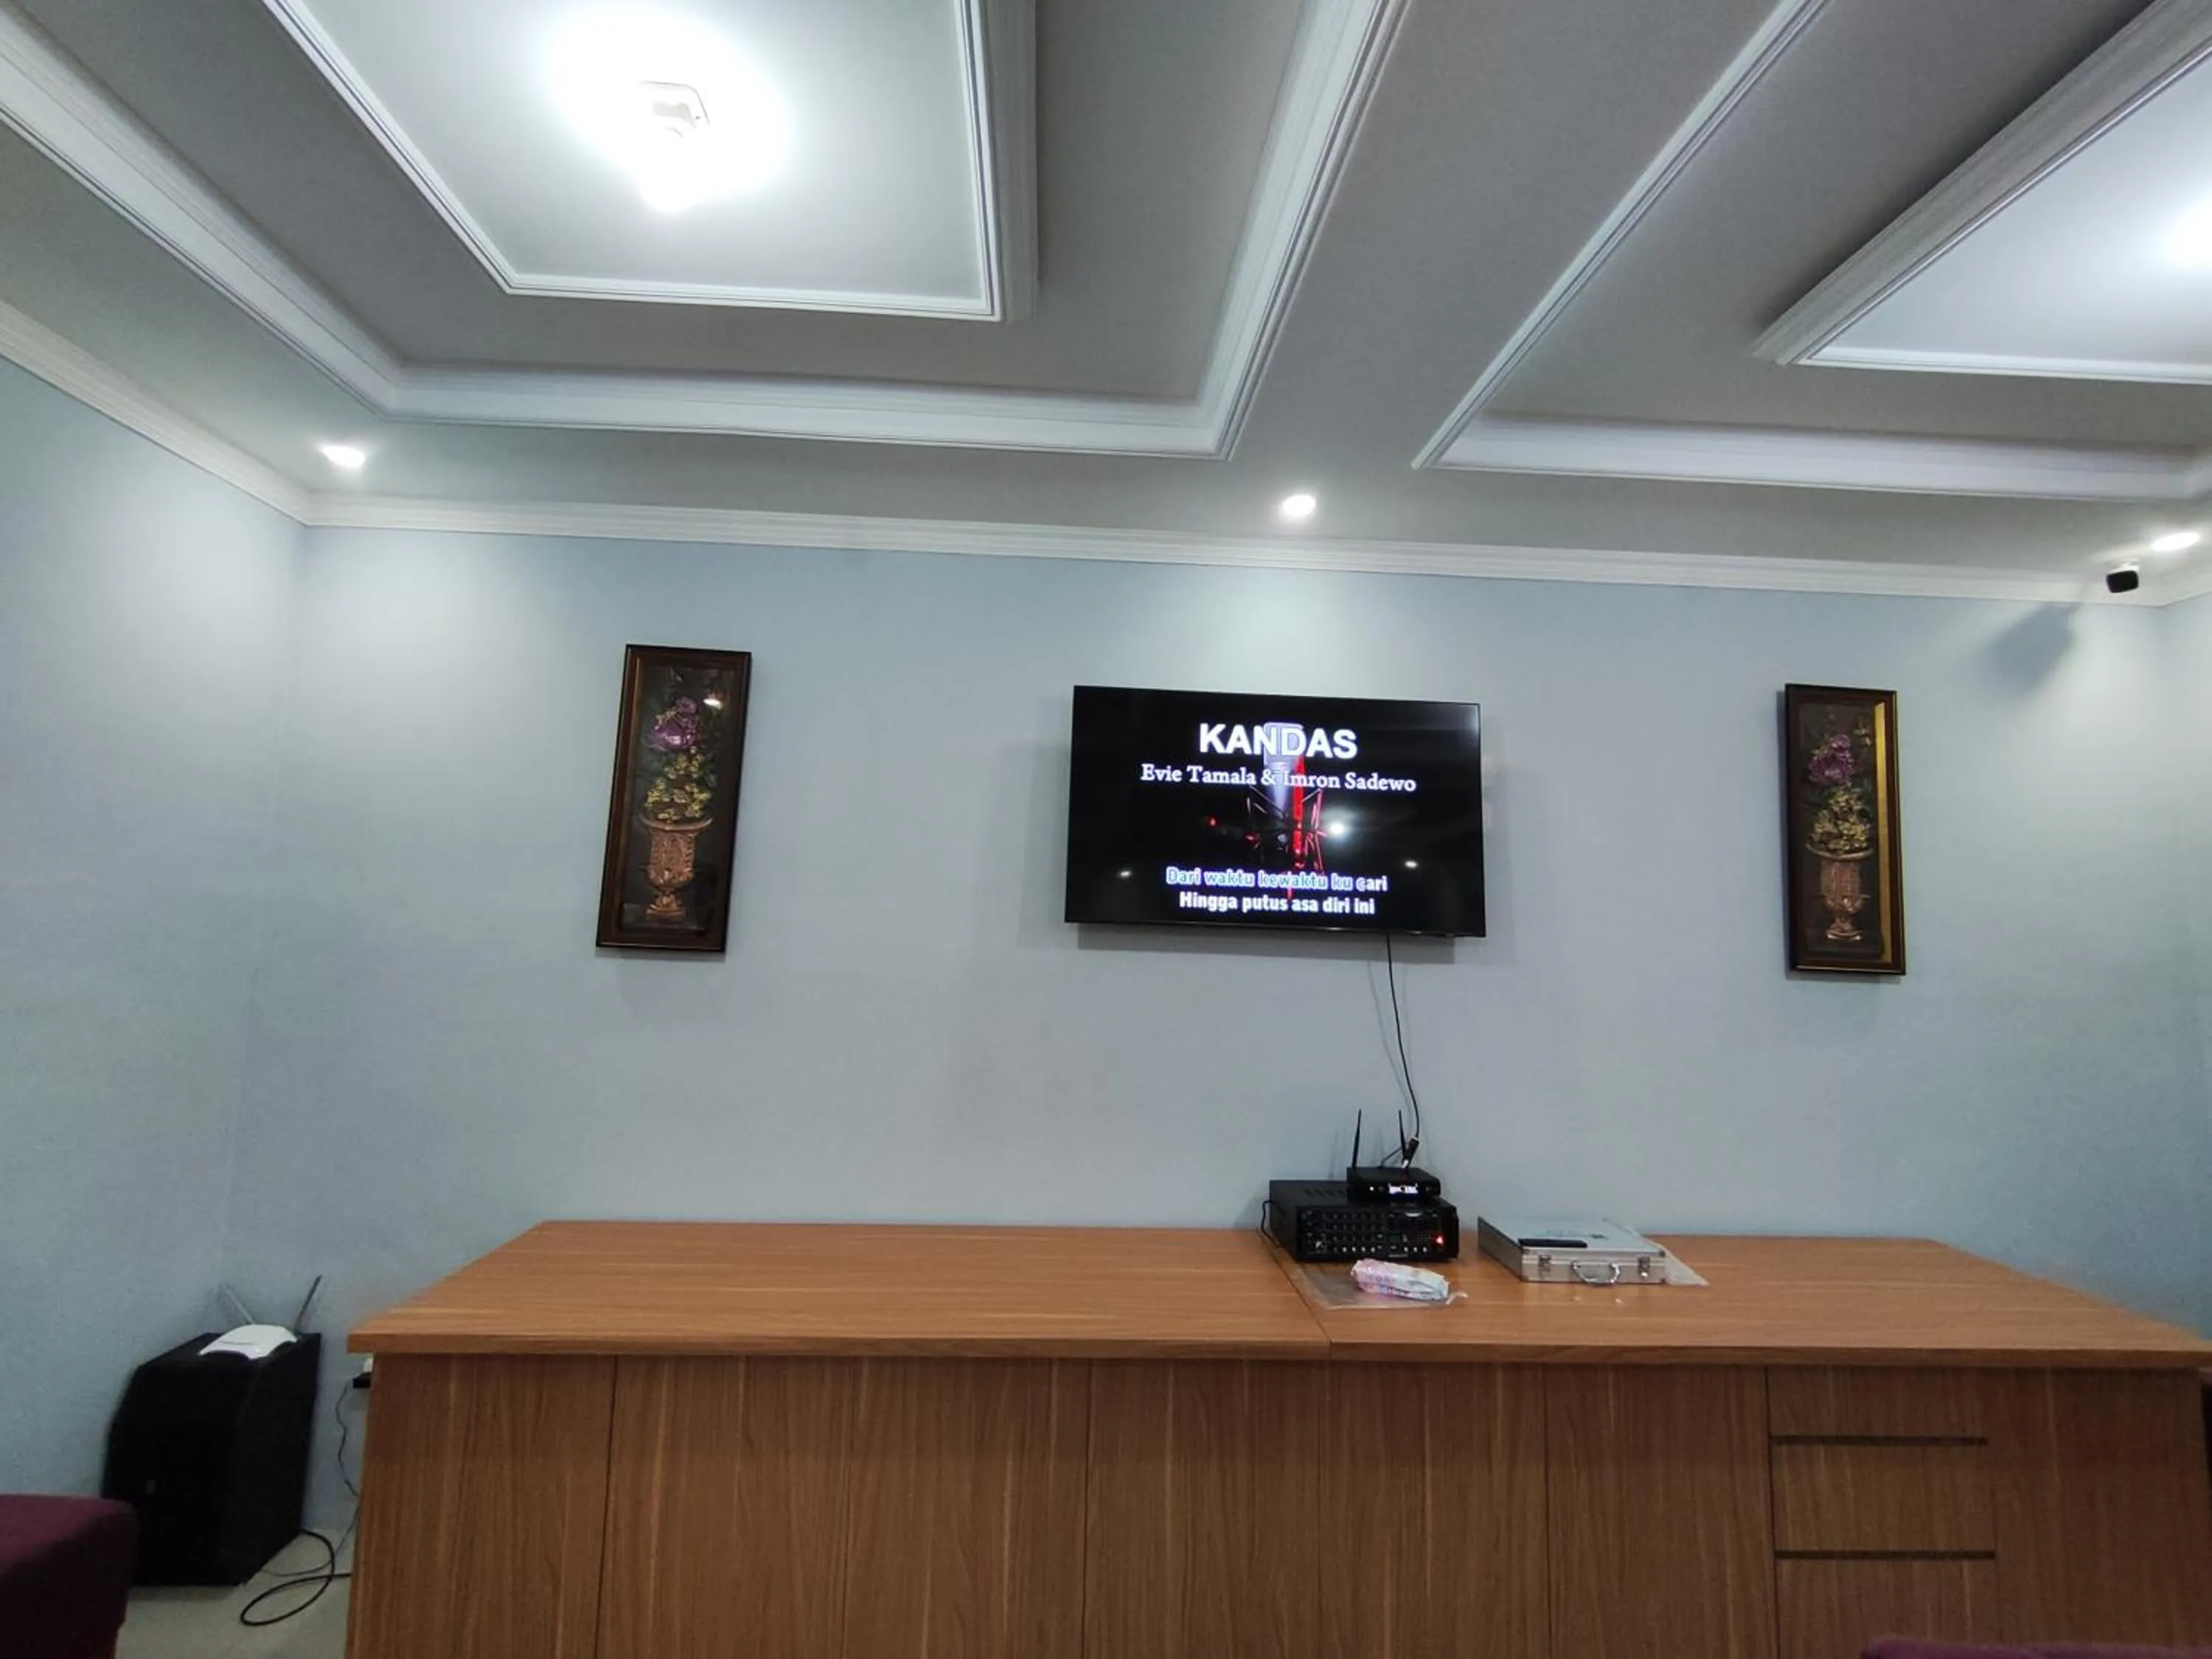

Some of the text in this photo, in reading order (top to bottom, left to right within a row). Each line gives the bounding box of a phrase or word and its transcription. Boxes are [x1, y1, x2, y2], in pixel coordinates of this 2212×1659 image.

[1199, 723, 1358, 759] KANDAS
[1141, 765, 1416, 792] Evie Tamala & Imron Sadewo
[1166, 867, 1388, 891] Dari waktu kewaktu ku cari
[1180, 891, 1375, 914] Hingga putus asa diri ini
